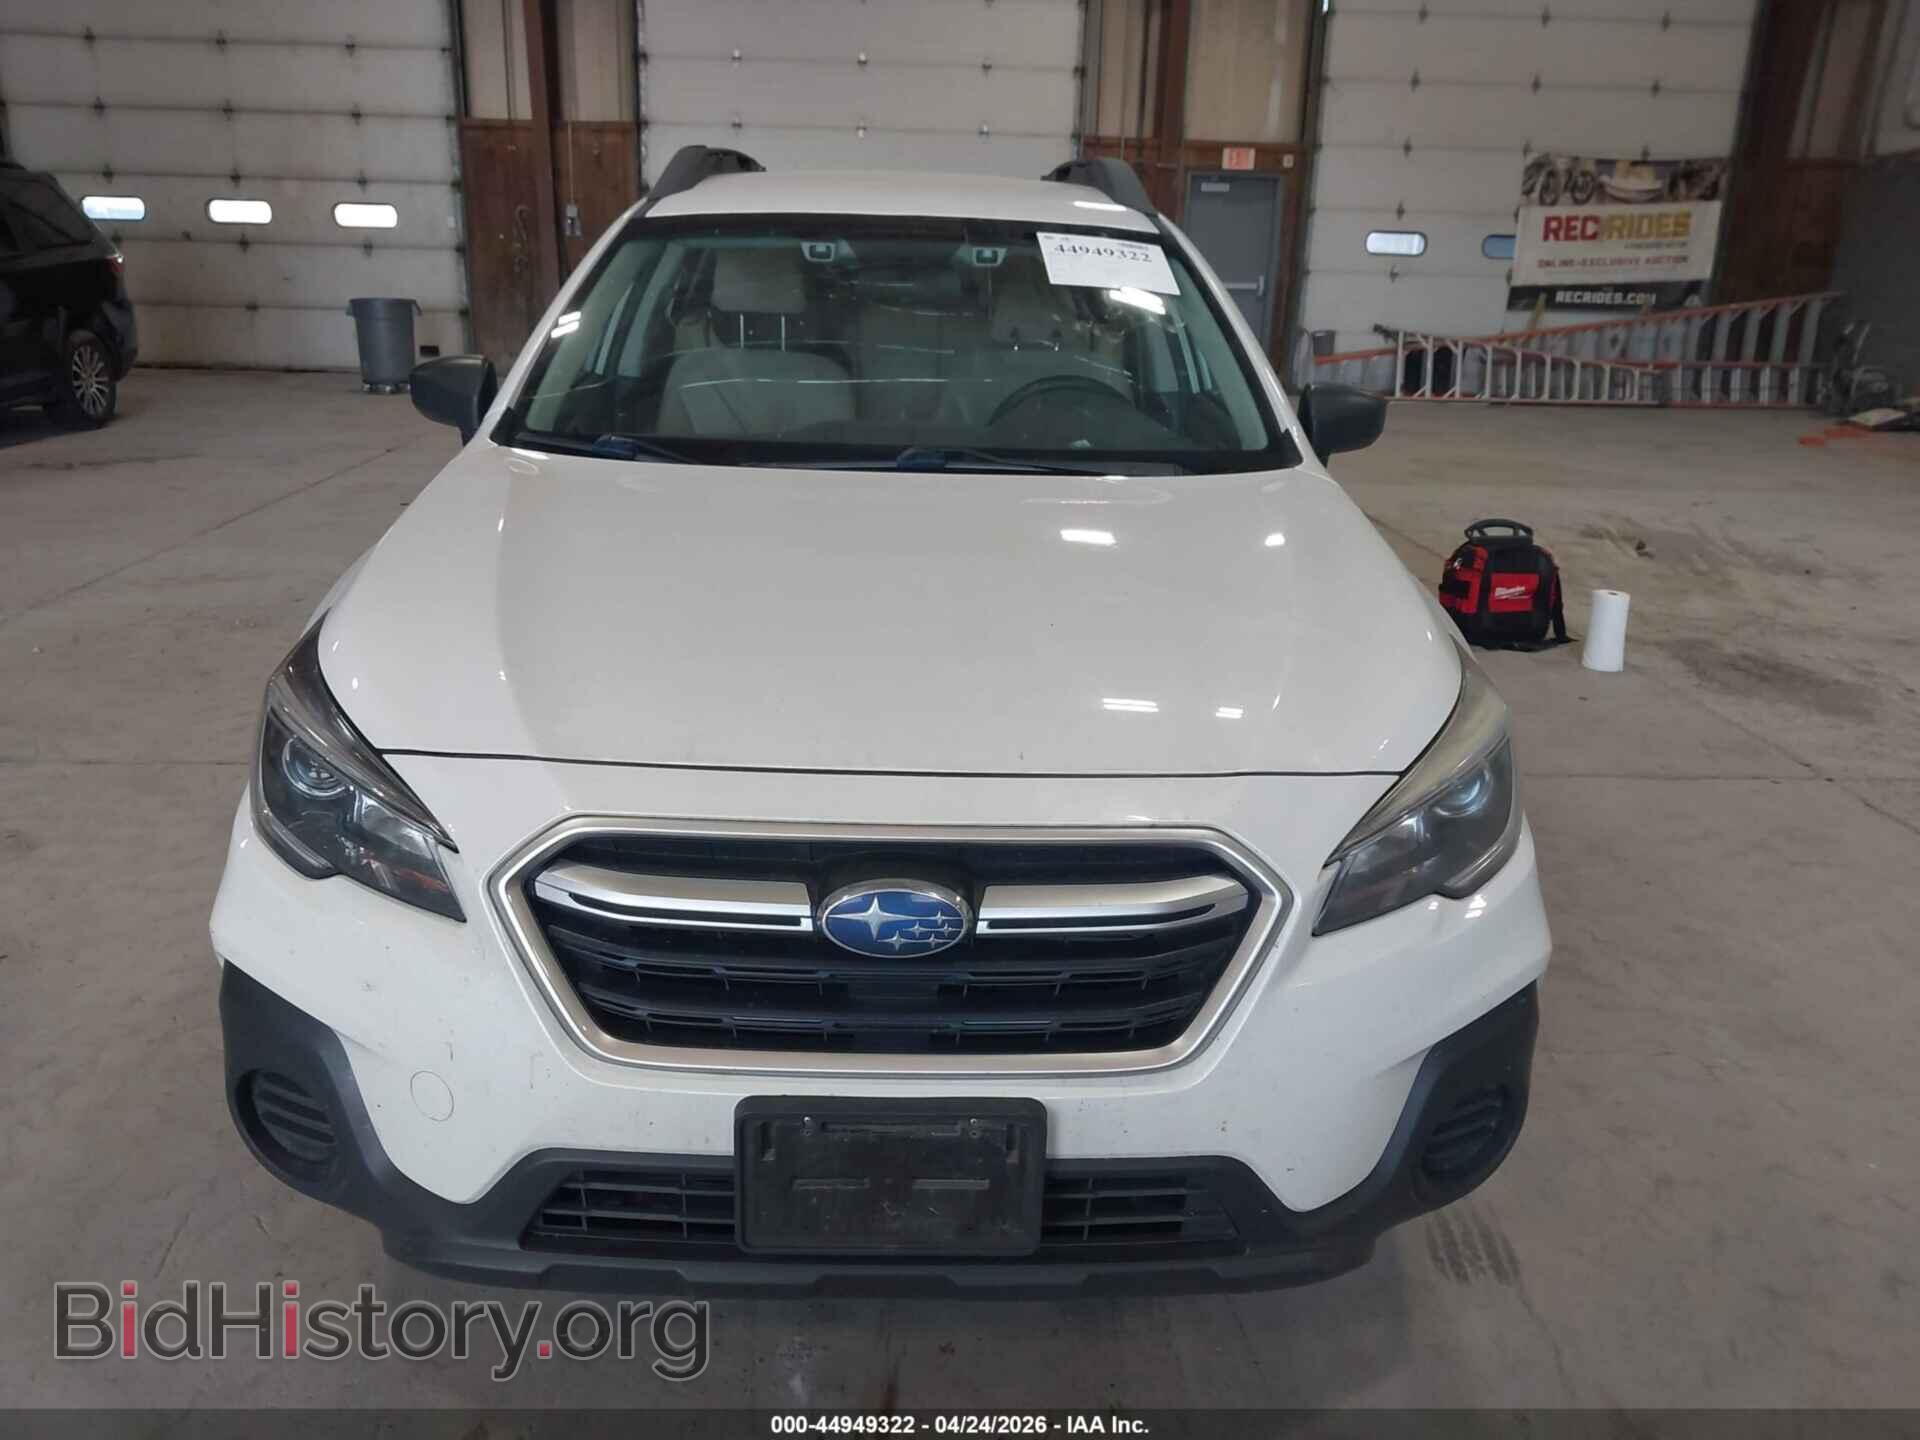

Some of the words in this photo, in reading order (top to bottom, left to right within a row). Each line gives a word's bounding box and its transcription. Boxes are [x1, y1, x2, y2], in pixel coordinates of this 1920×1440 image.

[1053, 244, 1152, 262] 44949322
[1645, 255, 1689, 265] AUCTION
[1555, 290, 1657, 305] RECRIDES.COM
